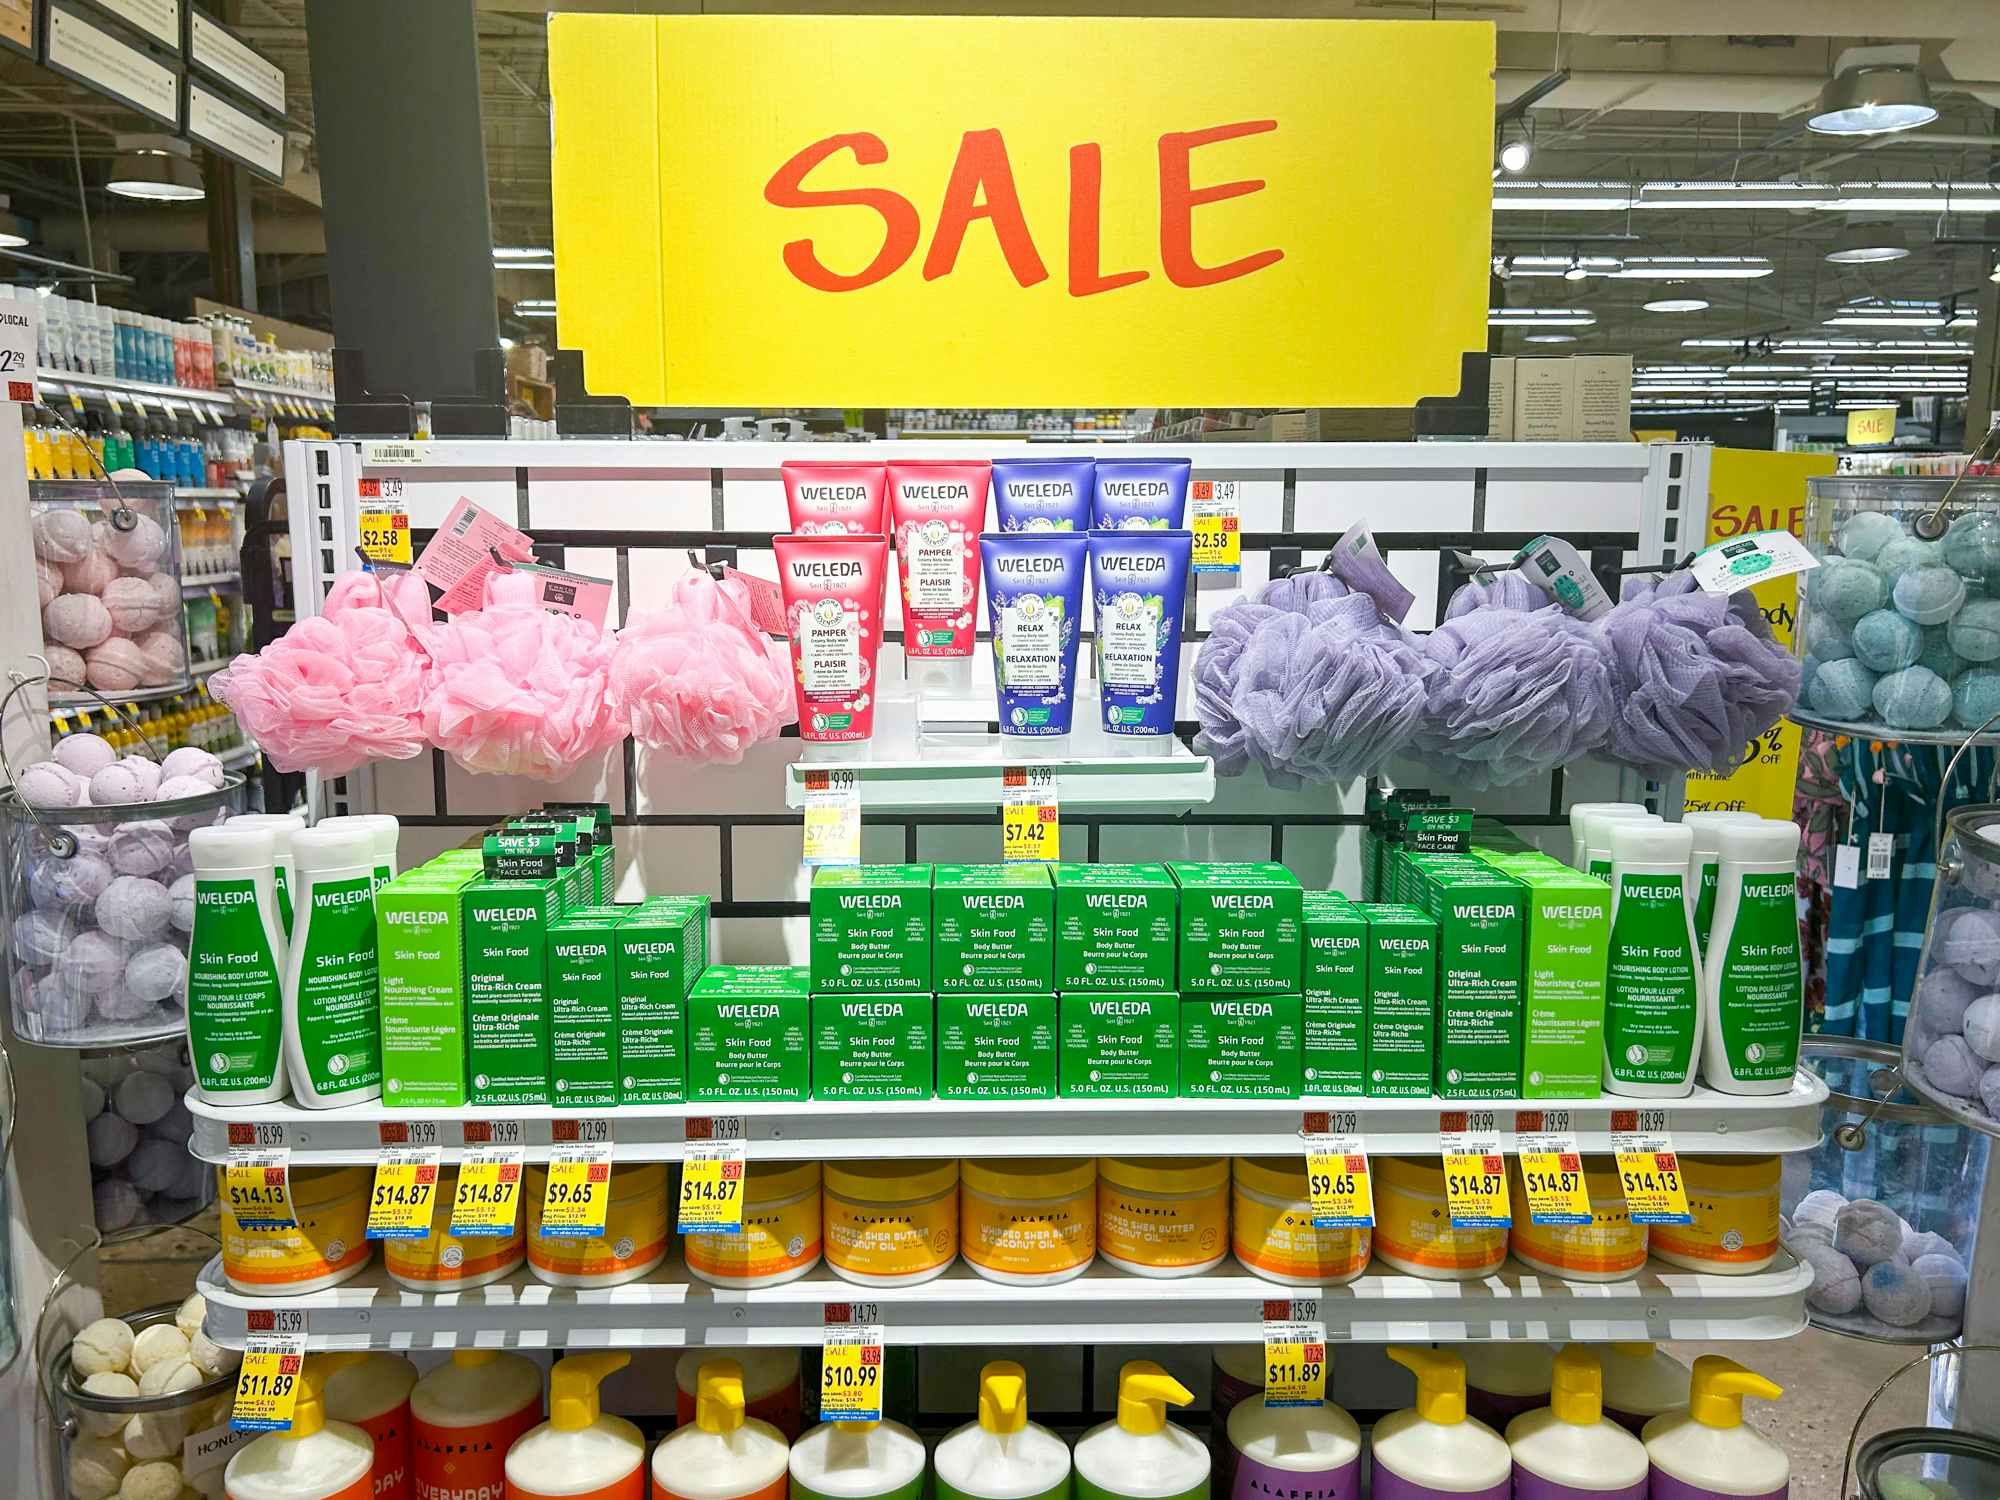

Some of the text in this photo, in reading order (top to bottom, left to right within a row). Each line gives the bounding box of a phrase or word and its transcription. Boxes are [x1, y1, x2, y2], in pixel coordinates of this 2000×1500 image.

[764, 119, 1284, 297] SALE
[4, 314, 29, 327] LOCAL
[1857, 419, 1884, 435] SALE
[801, 486, 867, 500] WELEDA
[903, 485, 969, 499] WELEDA
[1009, 482, 1073, 497] WELEDA
[1104, 482, 1169, 496] WELEDA
[364, 530, 398, 547] $2.58
[1194, 532, 1228, 548] $2.58
[793, 562, 863, 577] WELEDA
[997, 557, 1065, 573] WELEDA
[1100, 556, 1167, 571] WELEDA
[920, 578, 951, 586] PLAISIR
[1759, 602, 1793, 632] ody
[812, 628, 846, 637] PAMPER
[1017, 624, 1044, 632] RELAX
[1116, 622, 1141, 631] RELAX
[814, 660, 846, 668] PLAISIR
[1006, 655, 1056, 663] RELAXATION
[1105, 653, 1152, 662] RELAXATION
[1421, 815, 1460, 824] SAVE $3
[1006, 824, 1045, 841] $7.42
[1417, 833, 1458, 842] Skin Food
[498, 837, 540, 848] SAVE $3
[497, 858, 543, 868] Skin Food
[198, 890, 255, 905] WELEDA
[315, 888, 371, 907] WELEDA
[1623, 885, 1681, 899] WELEDA
[1744, 883, 1794, 898] WELEDA
[840, 895, 902, 909] WELEDA
[962, 895, 1024, 909] WELEDA
[1086, 894, 1148, 908] WELEDA
[1211, 895, 1273, 909] WELEDA
[385, 911, 448, 925] WELEDA
[473, 907, 537, 922] WELEDA
[1453, 905, 1515, 919] WELEDA
[1542, 905, 1603, 919] WELEDA
[848, 928, 893, 937] Skin Food
[970, 928, 1016, 937] Skin Food
[1219, 929, 1265, 938] Skin Food
[624, 942, 675, 954] WELEDA
[851, 943, 868, 951] Body
[1310, 937, 1360, 948] WELEDA
[1379, 939, 1429, 950] WELEDA
[1461, 944, 1506, 953] Skin Food
[1547, 944, 1592, 953] Skin Food
[395, 950, 440, 960] Skin Food
[483, 947, 529, 957] Skin Food
[556, 945, 607, 956] WELEDA
[862, 953, 875, 961] pour
[885, 952, 903, 960] Corps
[1621, 945, 1682, 958] Skin Food
[1741, 944, 1793, 956] Skin Food
[199, 951, 259, 964] Skin Food
[316, 948, 375, 968] Skin Food
[246, 970, 268, 979] LOTION
[630, 970, 669, 979] Skin Food
[1316, 965, 1354, 973] Skin Food
[1384, 966, 1401, 974] Skin
[384, 976, 404, 986] Light
[471, 974, 504, 983] Original
[562, 973, 601, 982] Skin Food
[1191, 979, 1204, 987] 5.0
[1222, 979, 1234, 987] OZ.
[1236, 979, 1252, 987] U.S.
[384, 986, 453, 995] Nourishing Cream
[471, 982, 542, 991] Ultra-Rich Cream
[717, 1004, 780, 1018] WELEDA
[842, 1003, 903, 1017] WELEDA
[967, 1003, 1028, 1017] WELEDA
[1090, 1002, 1151, 1016] WELEDA
[1210, 1002, 1272, 1016] WELEDA
[473, 1013, 539, 1023] Crème Originale
[1218, 1036, 1264, 1045] Skin Food
[1311, 1175, 1355, 1195] $9.65
[1449, 1175, 1501, 1195] $14.87
[1527, 1173, 1579, 1193] $14.87
[1624, 1173, 1678, 1192] $14.13
[230, 1186, 284, 1204] $14.13
[375, 1185, 430, 1206] $14.87
[458, 1183, 513, 1204] $14.87
[549, 1183, 592, 1204] $9.65
[683, 1180, 737, 1201] $14.87
[824, 1366, 877, 1388] $10.99
[1269, 1363, 1321, 1383] $11.89
[240, 1373, 293, 1397] $11.89
[1250, 1479, 1336, 1500] ALAFFIA
